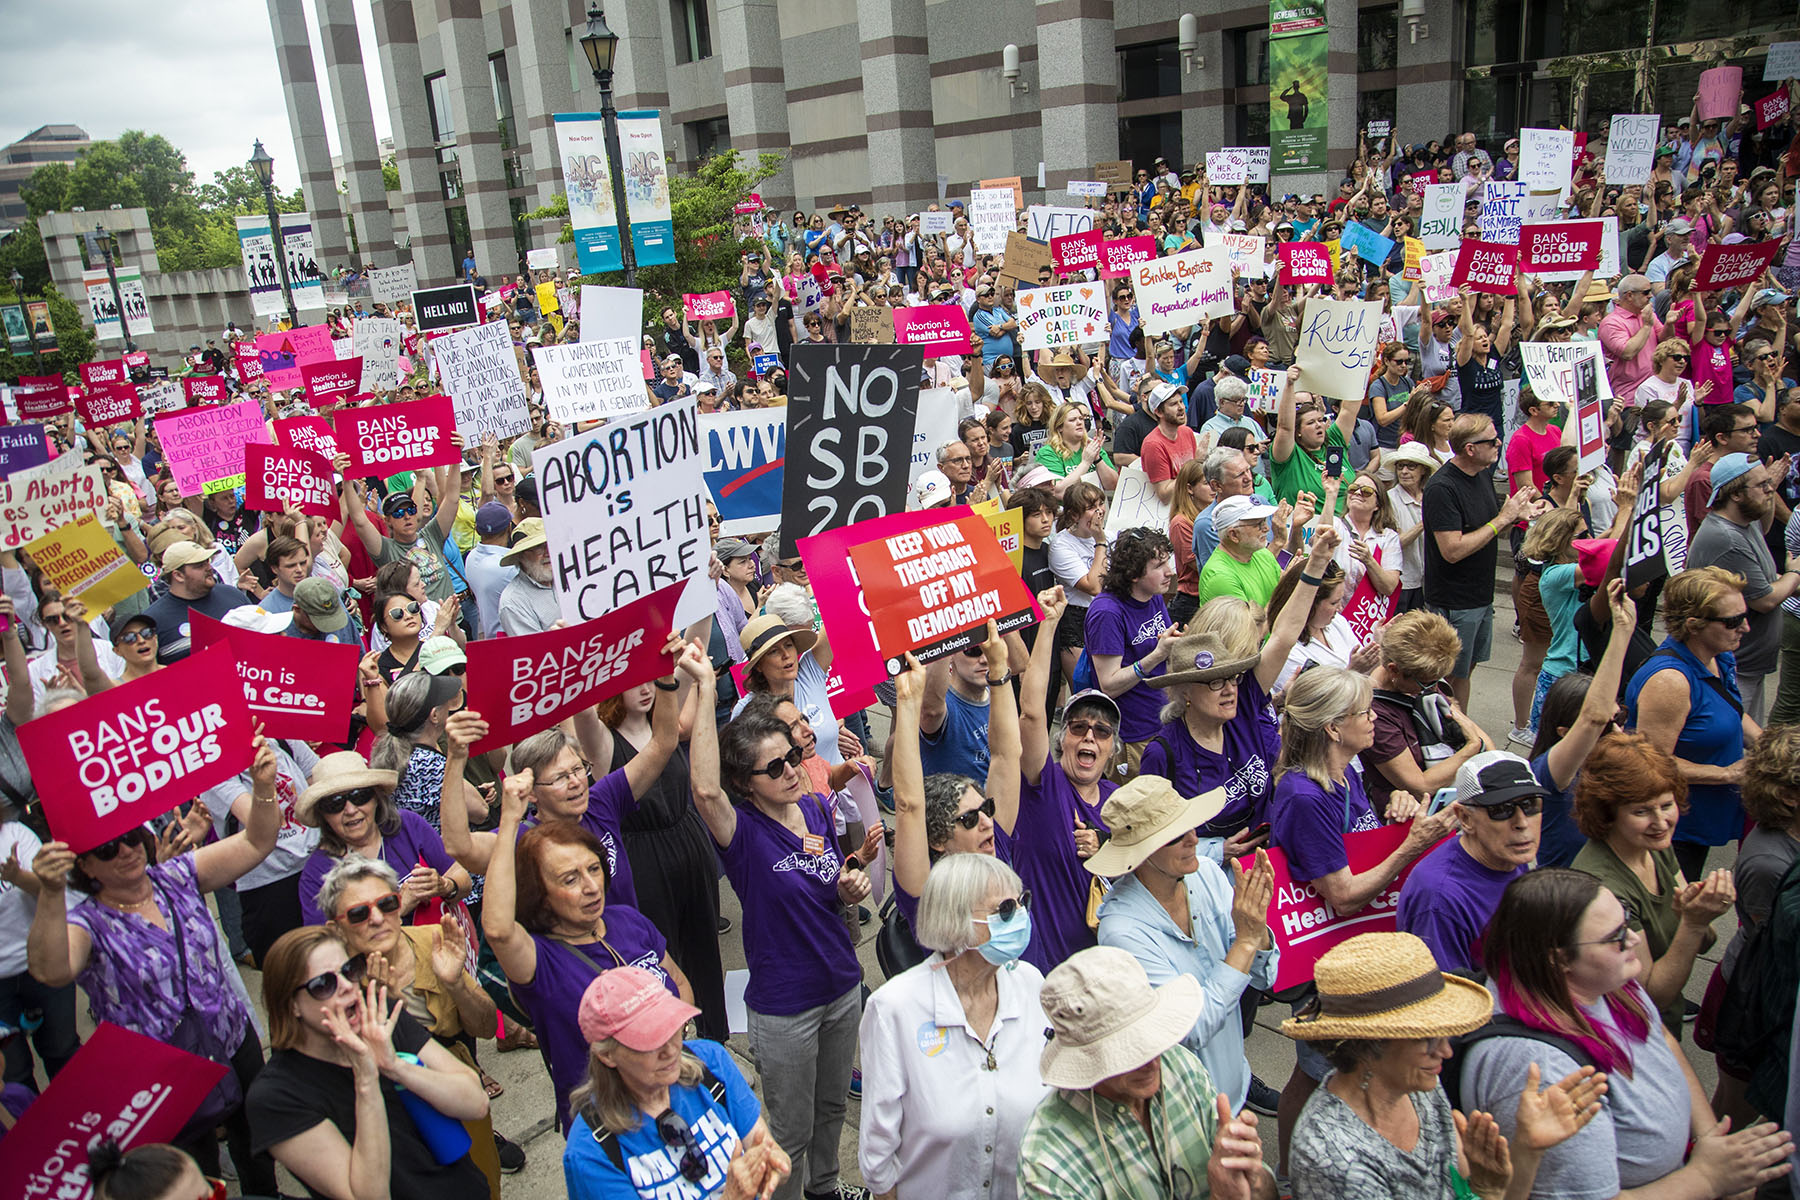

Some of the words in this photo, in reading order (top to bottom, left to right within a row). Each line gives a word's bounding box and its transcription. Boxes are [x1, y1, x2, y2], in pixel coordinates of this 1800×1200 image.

[1613, 118, 1659, 136] TRUST
[1610, 137, 1655, 150] WOMEN
[1207, 154, 1222, 168] HER
[1226, 154, 1246, 168] BODY
[1216, 164, 1231, 172] HER
[1210, 172, 1242, 180] CHOICE
[1487, 183, 1511, 200] ALL
[1515, 182, 1526, 197] I
[1483, 200, 1520, 216] WANT
[1032, 212, 1091, 240] VETO
[1422, 216, 1460, 236] YIKES
[1060, 238, 1086, 250] BANS
[1482, 230, 1497, 242] DAY
[1533, 233, 1568, 244] BANS
[1062, 248, 1080, 258] OFF
[1107, 245, 1132, 256] BANS
[1108, 254, 1126, 264] OFF
[1127, 251, 1148, 260] OUR
[1291, 249, 1318, 259] BANS
[1473, 250, 1504, 264] BANS
[1531, 244, 1558, 254] OFF
[1558, 242, 1588, 252] OUR
[1064, 253, 1098, 266] BODIES
[1291, 258, 1310, 268] OFF
[1312, 259, 1328, 268] OUR
[1469, 260, 1494, 272] OFF
[1494, 264, 1512, 275] OUR
[1531, 252, 1582, 264] BODIES
[1714, 264, 1738, 274] OFF
[1738, 257, 1766, 270] OUR
[1718, 252, 1753, 264] BANS
[1140, 265, 1178, 287] Binkley
[1178, 259, 1213, 278] Baptists
[1292, 267, 1326, 276] BODIES
[1466, 271, 1510, 286] BODIES
[1709, 269, 1756, 283] BODIES
[1045, 290, 1072, 304] KEEP
[1152, 297, 1200, 317] Reproductive
[1201, 286, 1229, 305] Health
[424, 305, 448, 318] HELL
[449, 301, 468, 314] NO!
[1020, 304, 1103, 331] REPRODUCTIVE
[906, 321, 942, 332] Abortion
[944, 319, 950, 328] is
[907, 330, 938, 342] Health
[940, 328, 964, 338] Care.
[1046, 320, 1077, 332] CARE
[1303, 309, 1374, 354] Ruth
[436, 338, 458, 352] ROE
[474, 323, 506, 340] WADE
[1046, 331, 1079, 344] SAFE!
[442, 350, 464, 365] WAS
[466, 344, 488, 358] NOT
[489, 336, 510, 350] THE
[545, 350, 554, 362] IF
[560, 348, 565, 362] I
[568, 342, 610, 360] WANTED
[616, 340, 634, 356] THE
[101, 369, 118, 377] OUR
[448, 354, 504, 378] BEGINNING
[562, 360, 624, 379] GOVERNMENT
[1527, 364, 1546, 380] DAY
[90, 374, 116, 383] BODIES
[191, 380, 208, 388] BANS
[204, 384, 219, 392] OUR
[312, 374, 340, 386] Abortion
[313, 381, 336, 392] Health
[338, 378, 356, 388] Care.
[556, 385, 570, 398] IN
[574, 382, 588, 396] MY
[594, 375, 632, 394] UTERUS
[448, 381, 460, 396] OF
[462, 392, 472, 406] IT
[477, 386, 500, 402] WAS
[503, 378, 523, 394] THE
[822, 364, 898, 420] NO
[87, 396, 114, 408] BANS
[89, 406, 108, 416] OFF
[108, 398, 132, 411] OUR
[454, 408, 476, 425] END
[478, 404, 490, 419] OF
[493, 392, 526, 414] WOMEN
[555, 405, 569, 418] I'D
[600, 400, 607, 412] A
[610, 394, 648, 410] SENATOR
[92, 407, 132, 424] BODIES
[177, 405, 243, 430] ABORTION
[476, 412, 508, 432] DYING
[163, 438, 172, 448] A
[172, 428, 219, 446] PERSONAL
[222, 417, 263, 436] DECISION
[289, 425, 317, 442] BANS
[357, 416, 408, 435] BANS
[500, 418, 532, 438] THEM!
[2, 433, 38, 448] Faith
[168, 443, 210, 462] BETWEEN
[214, 441, 222, 451] A
[224, 431, 258, 448] WOMAN
[315, 434, 338, 450] OUR
[358, 432, 396, 450] OFF
[397, 426, 440, 444] OUR
[703, 422, 786, 472] LWV
[200, 454, 218, 468] HER
[362, 442, 434, 464] BODIES
[542, 405, 700, 515] ABORTION
[806, 426, 889, 490] SB
[264, 456, 312, 474] BANS
[25, 472, 94, 503] Aborto
[181, 474, 200, 486] NOT
[206, 476, 234, 492] VETO
[263, 472, 298, 486] OFF
[299, 474, 333, 495] OUR
[264, 486, 330, 506] BODIES
[608, 490, 634, 517] is
[4, 506, 28, 522] es
[40, 491, 104, 517] cuidado
[807, 494, 886, 536] 20
[5, 524, 34, 546] de
[558, 494, 704, 593] HEALTH
[884, 532, 924, 562] KEEP
[926, 522, 964, 548] YOUR
[32, 542, 62, 564] STOP
[42, 548, 88, 578] FORCED
[52, 547, 124, 590] PREGNANCY.
[893, 544, 978, 589] THEOCRACY
[578, 538, 699, 622] CARE
[920, 580, 950, 610] OFF
[951, 570, 978, 599] MY
[906, 590, 1002, 644] DEMOCRACY
[942, 636, 970, 652] Atheists
[510, 669, 576, 704] OFF
[579, 628, 646, 676] OUR
[512, 634, 604, 683] BANS
[278, 665, 296, 685] is
[264, 684, 326, 708] Care.
[510, 652, 630, 727] BODIES
[68, 698, 167, 762] BANS
[78, 740, 148, 791] OFF
[150, 703, 228, 755] OUR
[91, 737, 222, 818] BODIES
[70, 1110, 102, 1132] is
